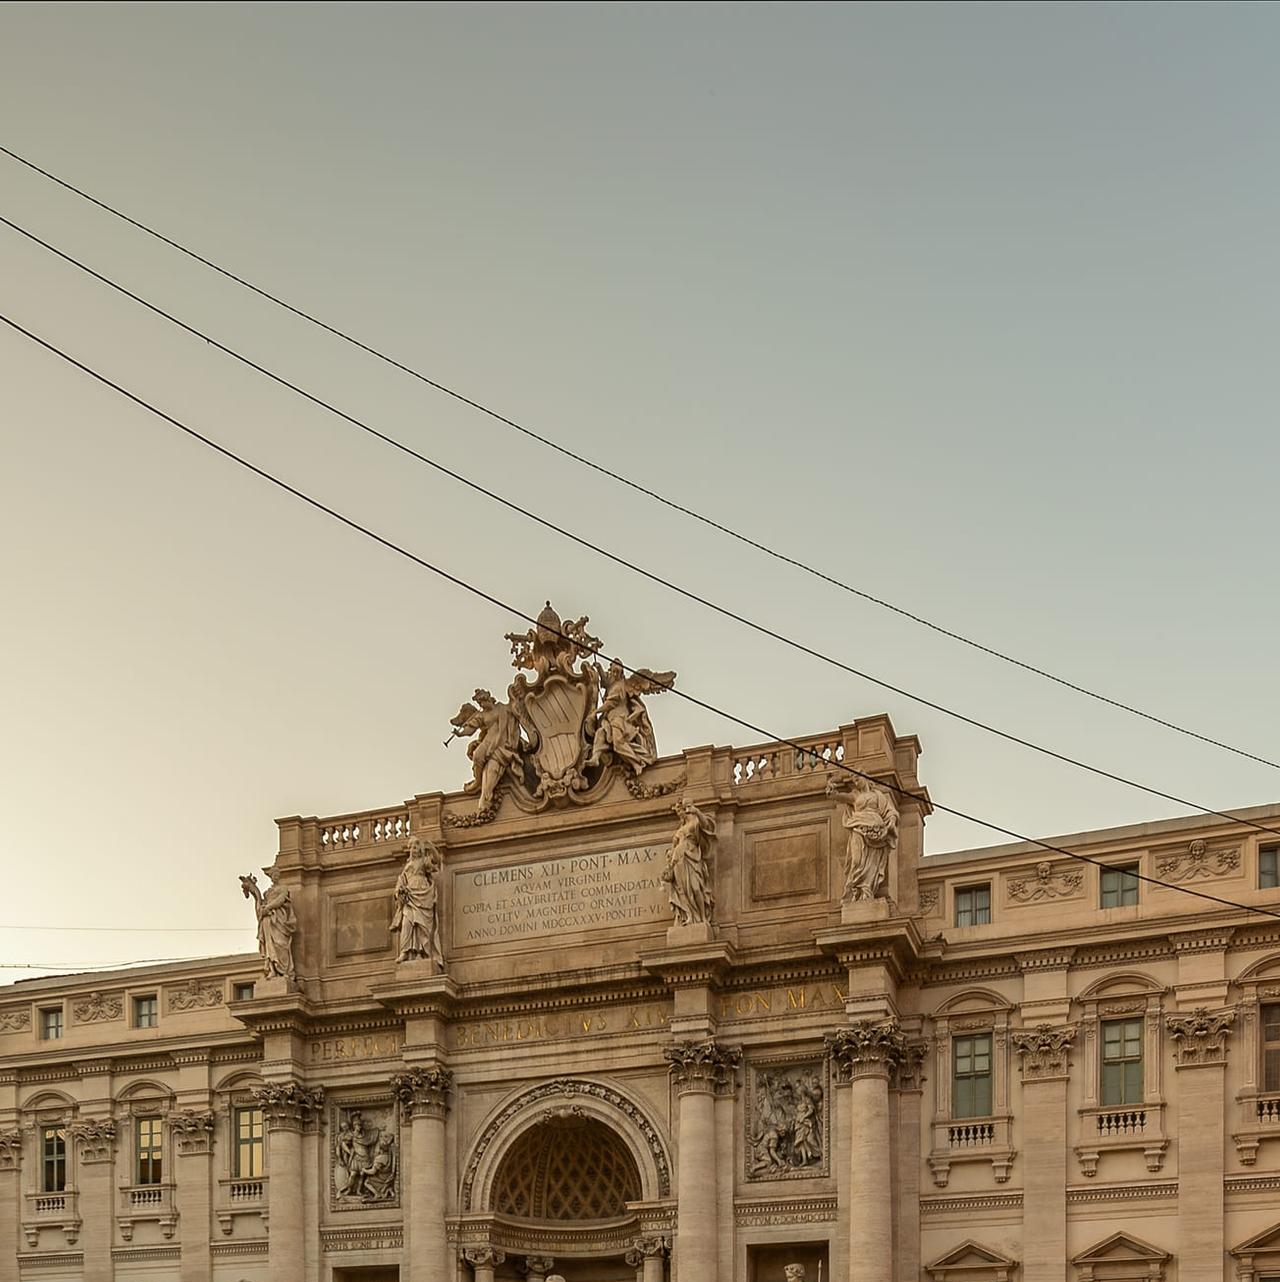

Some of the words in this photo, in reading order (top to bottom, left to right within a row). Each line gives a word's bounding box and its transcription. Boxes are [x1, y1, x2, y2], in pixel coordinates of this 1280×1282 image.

[473, 866, 533, 887] CLEMENS
[514, 880, 551, 895] AQVAM
[559, 871, 611, 887] VIRGINEM
[462, 902, 492, 914] COPIA
[496, 899, 509, 910] ET
[511, 889, 576, 908] SALVBRITATE
[488, 910, 520, 924] CVLTV
[526, 902, 585, 919] MAGNIFICO
[590, 894, 638, 909] ORNAVIT
[467, 927, 497, 939] ANNO
[499, 921, 537, 935] DOMINI
[784, 983, 848, 1010] MAX
[627, 1005, 670, 1028] XIV
